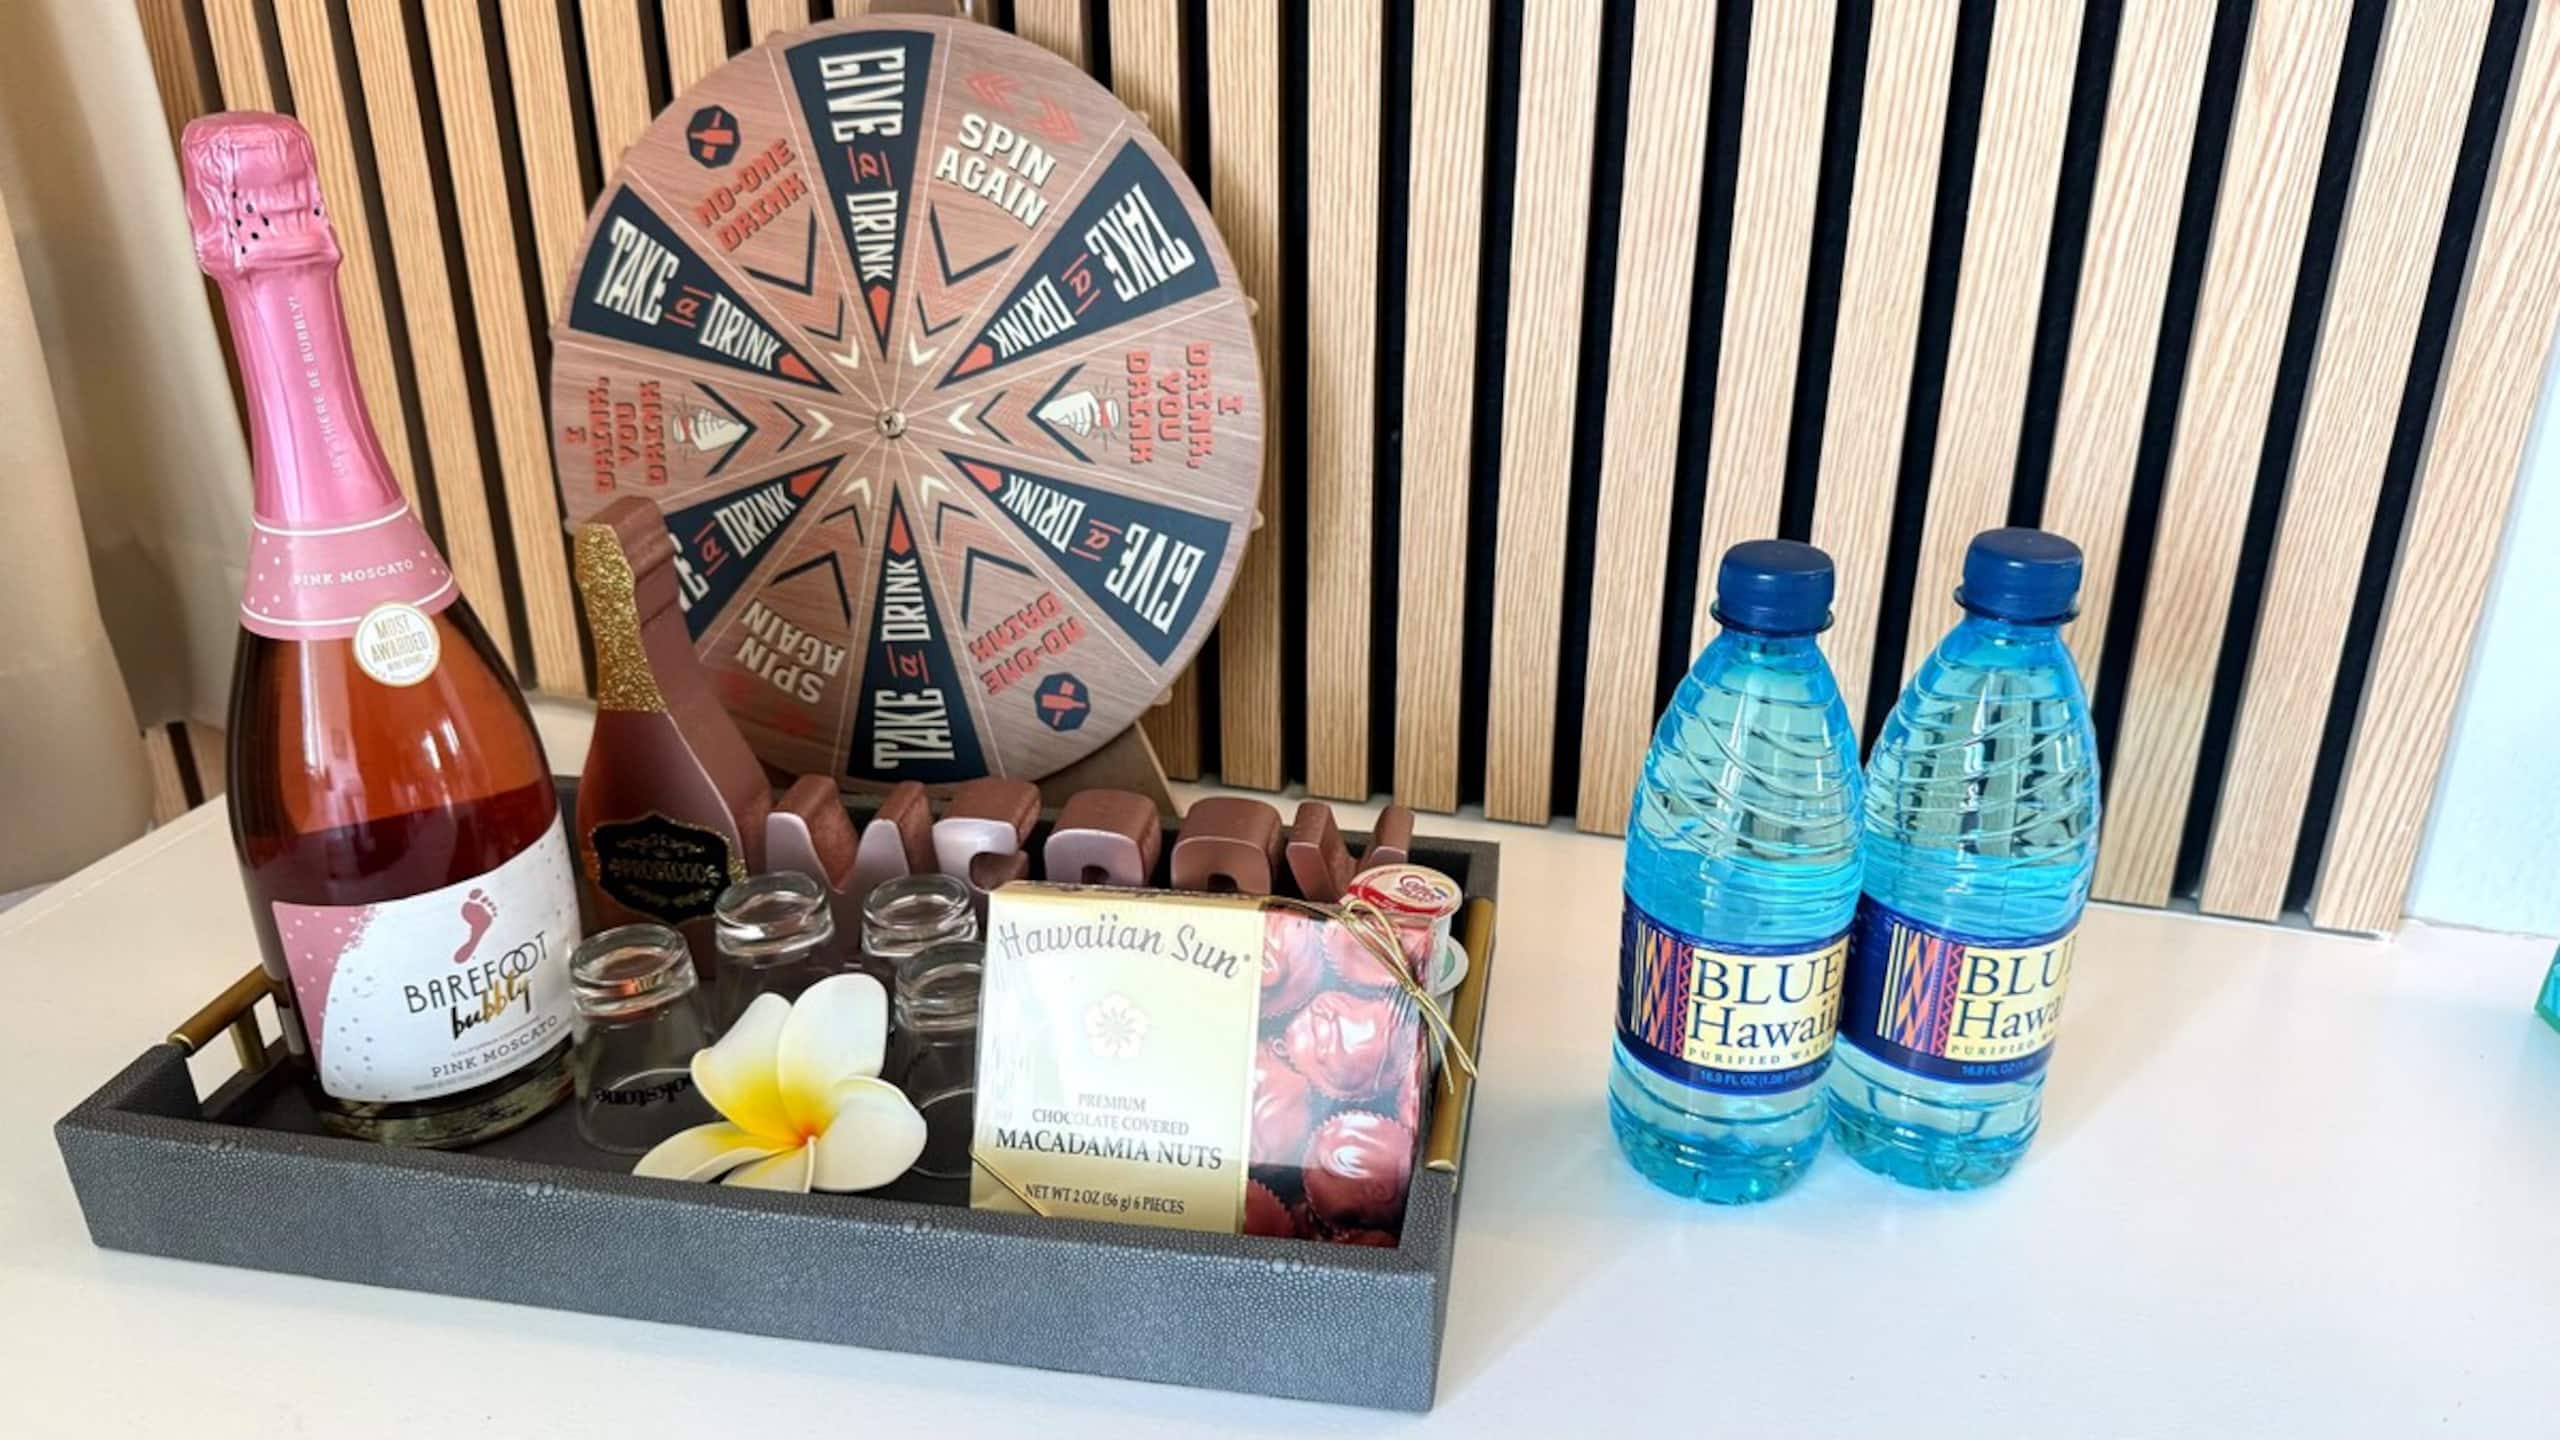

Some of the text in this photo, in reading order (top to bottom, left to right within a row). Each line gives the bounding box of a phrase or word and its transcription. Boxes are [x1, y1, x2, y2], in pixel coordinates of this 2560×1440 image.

[694, 138, 796, 228] NO-ONE
[818, 47, 906, 282] GIVE a DRINK
[958, 112, 1056, 188] SPIN
[717, 173, 809, 252] DRINK
[935, 146, 1049, 229] AGAIN
[593, 216, 782, 371] TAKE a DRINK
[987, 182, 1197, 358] TAKE a DRINK
[615, 402, 639, 463] YOU
[640, 381, 667, 485] DRINK
[1127, 351, 1153, 464] DRINK
[1157, 372, 1184, 441] YOU
[1218, 394, 1244, 415] I
[715, 484, 796, 559] DRINK
[1000, 474, 1206, 635] GIVE a DRINK
[294, 559, 414, 586] PINK MOSCATO
[370, 631, 429, 662] AWARDED
[374, 614, 410, 637] MOST
[740, 601, 846, 677] AGAIN
[968, 592, 1062, 662] DRINK
[980, 616, 1086, 695] NO-ONE
[735, 637, 825, 704] SPIN
[873, 558, 955, 769] TAKE a DRINK
[404, 931, 548, 1013] BAREFOOT
[998, 914, 1164, 961] Hawaiian
[452, 970, 531, 1040] bubbly
[1692, 949, 1843, 1005] BLUE
[432, 1056, 478, 1079] PINK
[483, 1015, 558, 1064] MOSCATO
[1688, 992, 1836, 1049] Hawaii
[1951, 1039, 2034, 1056] PURIFIED
[1689, 1048, 1780, 1065] PURIFIED
[1032, 1109, 1118, 1129] CHOCOLATE
[1122, 1115, 1190, 1136] COVERED
[1078, 1093, 1146, 1112] PREMIUM
[996, 1128, 1222, 1170] MACADAMIA NUTS
[1025, 1183, 1050, 1199] NET
[1052, 1186, 1072, 1203] WT
[1083, 1191, 1101, 1205] OZ
[1142, 1196, 1184, 1214] PIECES
